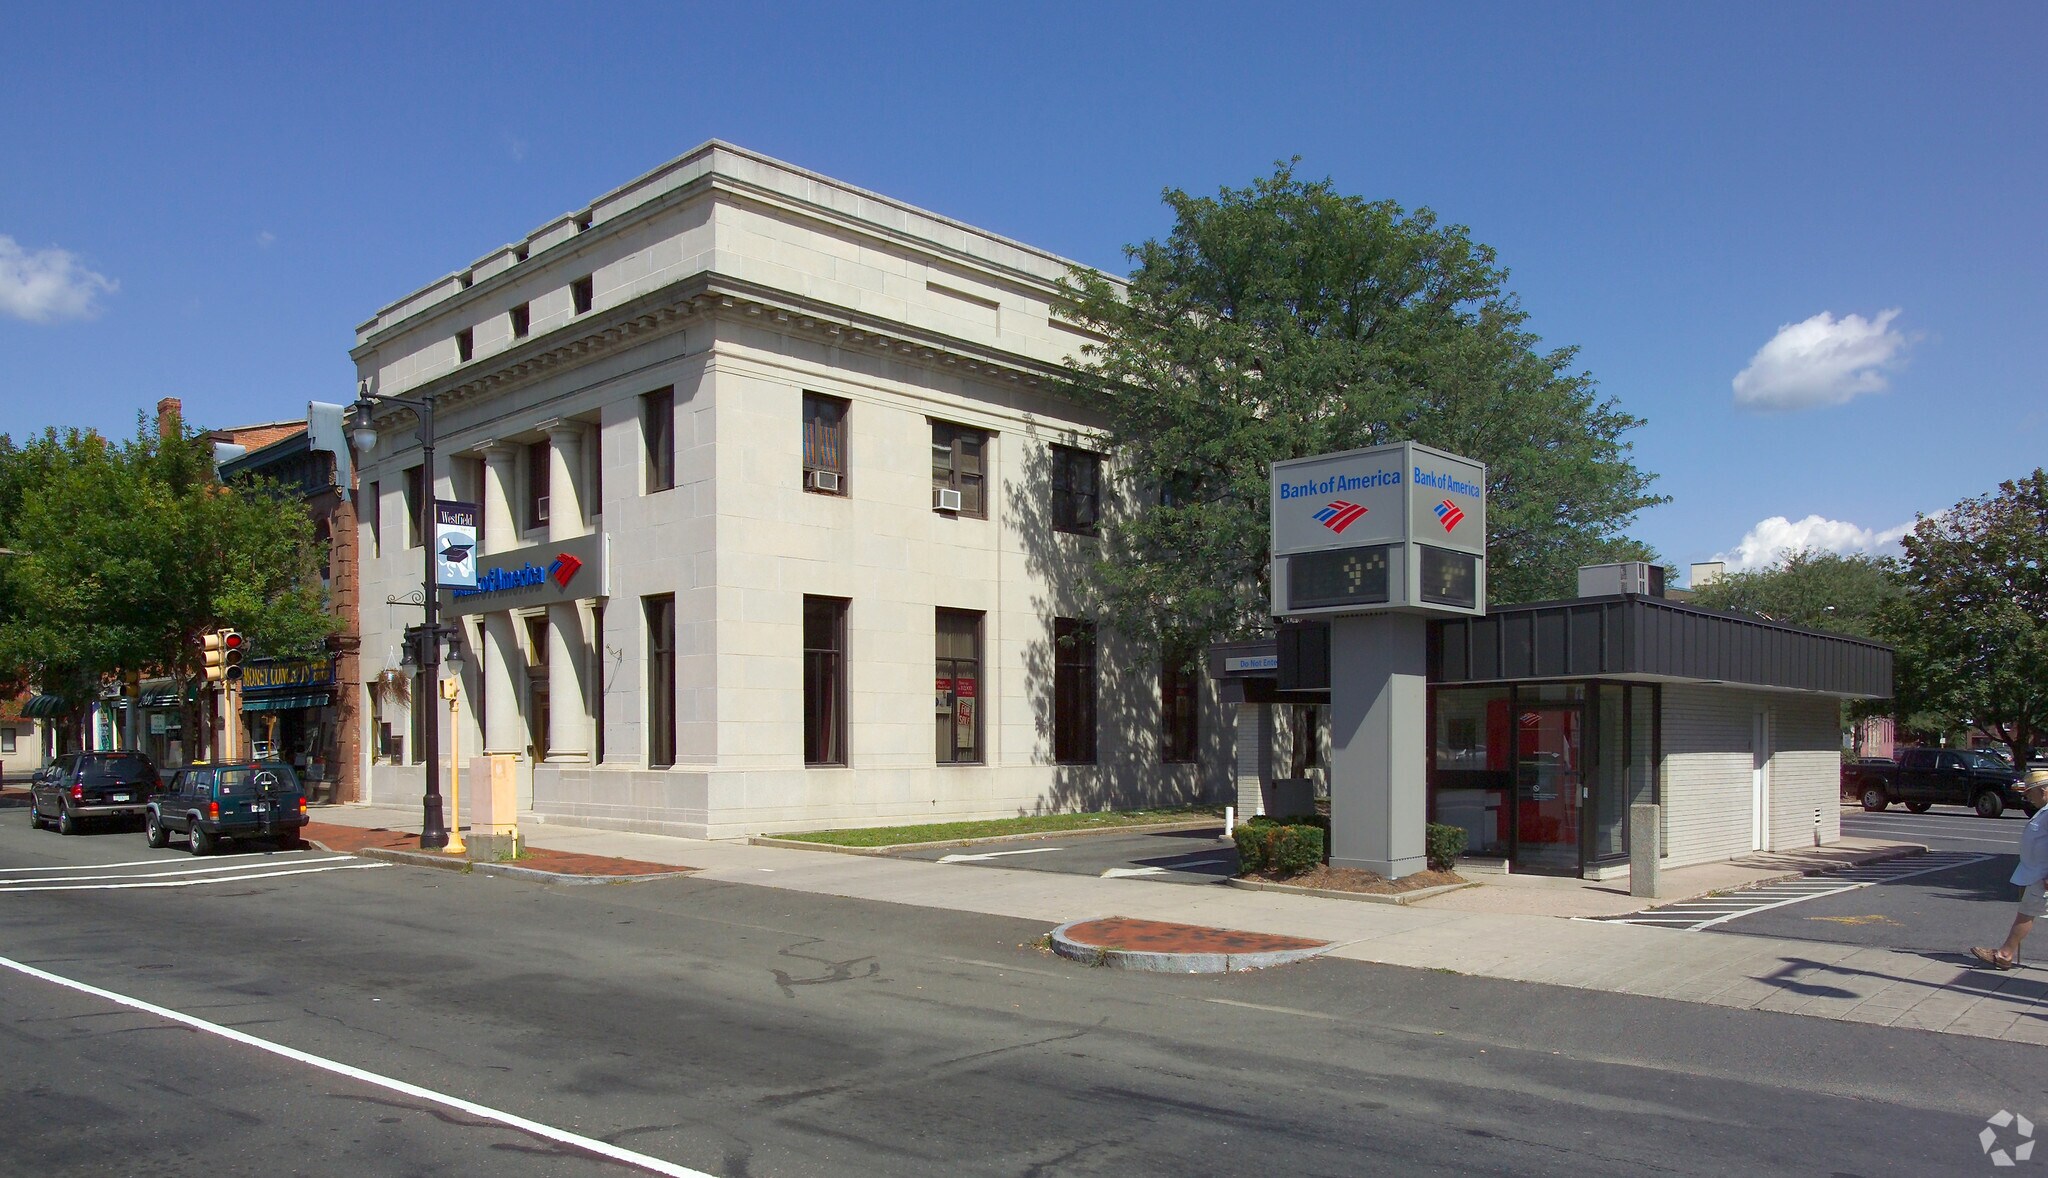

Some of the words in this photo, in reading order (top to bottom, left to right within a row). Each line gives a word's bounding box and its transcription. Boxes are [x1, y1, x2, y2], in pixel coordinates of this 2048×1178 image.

[1280, 479, 1318, 499] Bank
[1319, 476, 1335, 494] of
[1336, 469, 1401, 492] America
[1414, 466, 1437, 488] Bank
[1438, 473, 1446, 489] of
[1447, 474, 1480, 498] America
[441, 510, 473, 526] Westfield
[494, 561, 546, 592] America
[1240, 660, 1249, 668] Do
[1250, 659, 1262, 667] Not
[1263, 658, 1278, 667] Ente
[242, 666, 269, 686] MONEY
[960, 704, 971, 716] FOR
[959, 715, 970, 726] SALE
